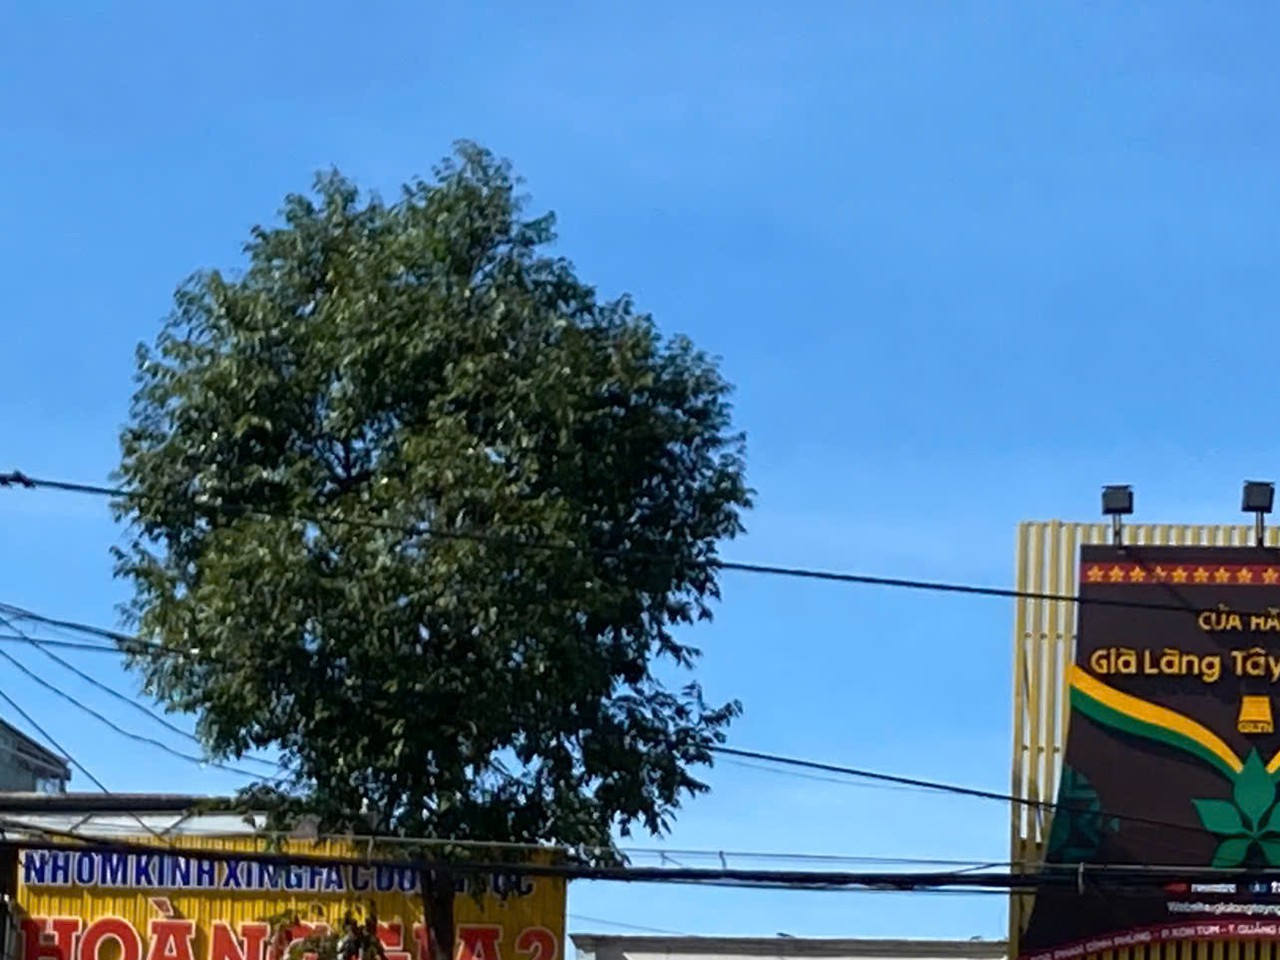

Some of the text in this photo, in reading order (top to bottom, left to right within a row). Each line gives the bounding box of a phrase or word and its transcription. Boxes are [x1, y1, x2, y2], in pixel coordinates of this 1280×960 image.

[1199, 603, 1242, 631] CỬA
[1090, 647, 1137, 674] Già
[1143, 648, 1221, 683] Làng
